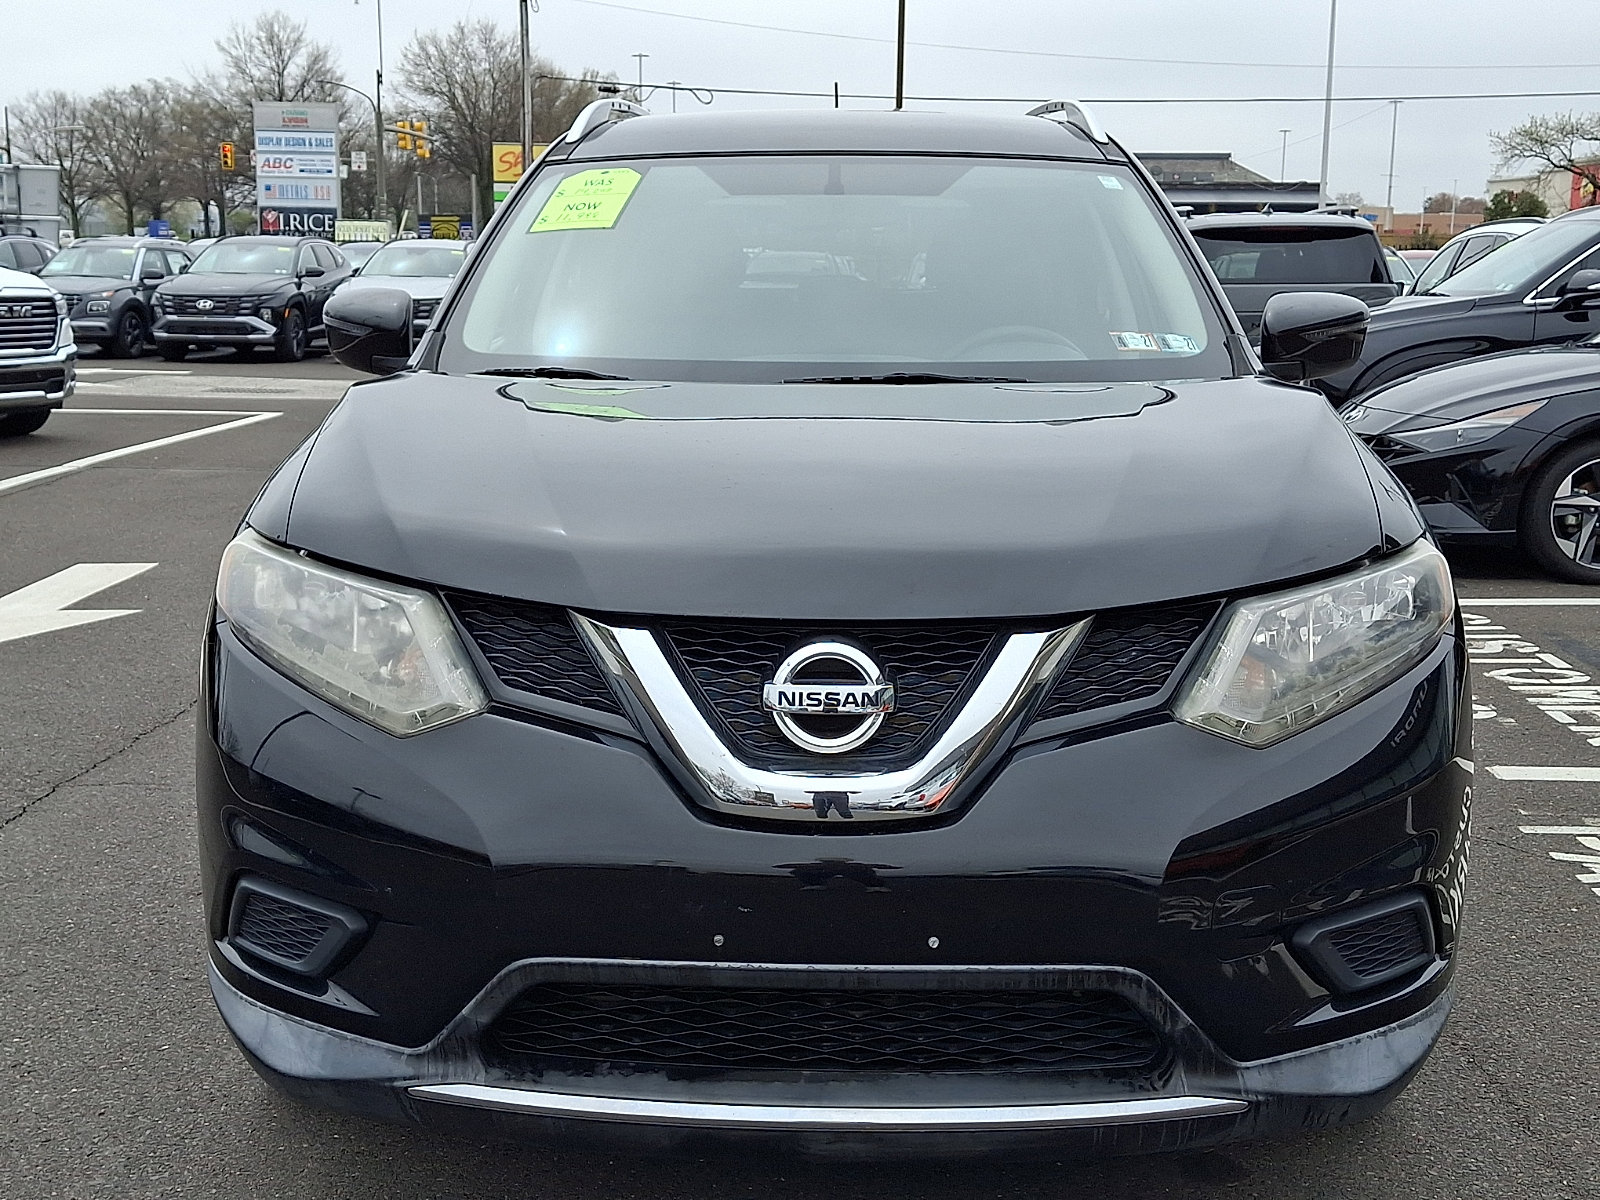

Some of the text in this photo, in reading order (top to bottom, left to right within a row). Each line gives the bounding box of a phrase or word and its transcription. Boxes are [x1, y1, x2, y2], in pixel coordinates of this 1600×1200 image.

[257, 136, 283, 146] DISPLAY
[284, 136, 307, 147] DESIGN
[314, 137, 333, 148] SALES
[261, 157, 294, 169] ABC
[584, 178, 614, 187] WAS
[563, 202, 602, 211] NOW
[280, 213, 334, 231] I.RICE
[0, 306, 32, 318] AM
[777, 690, 879, 708] NISSAN
